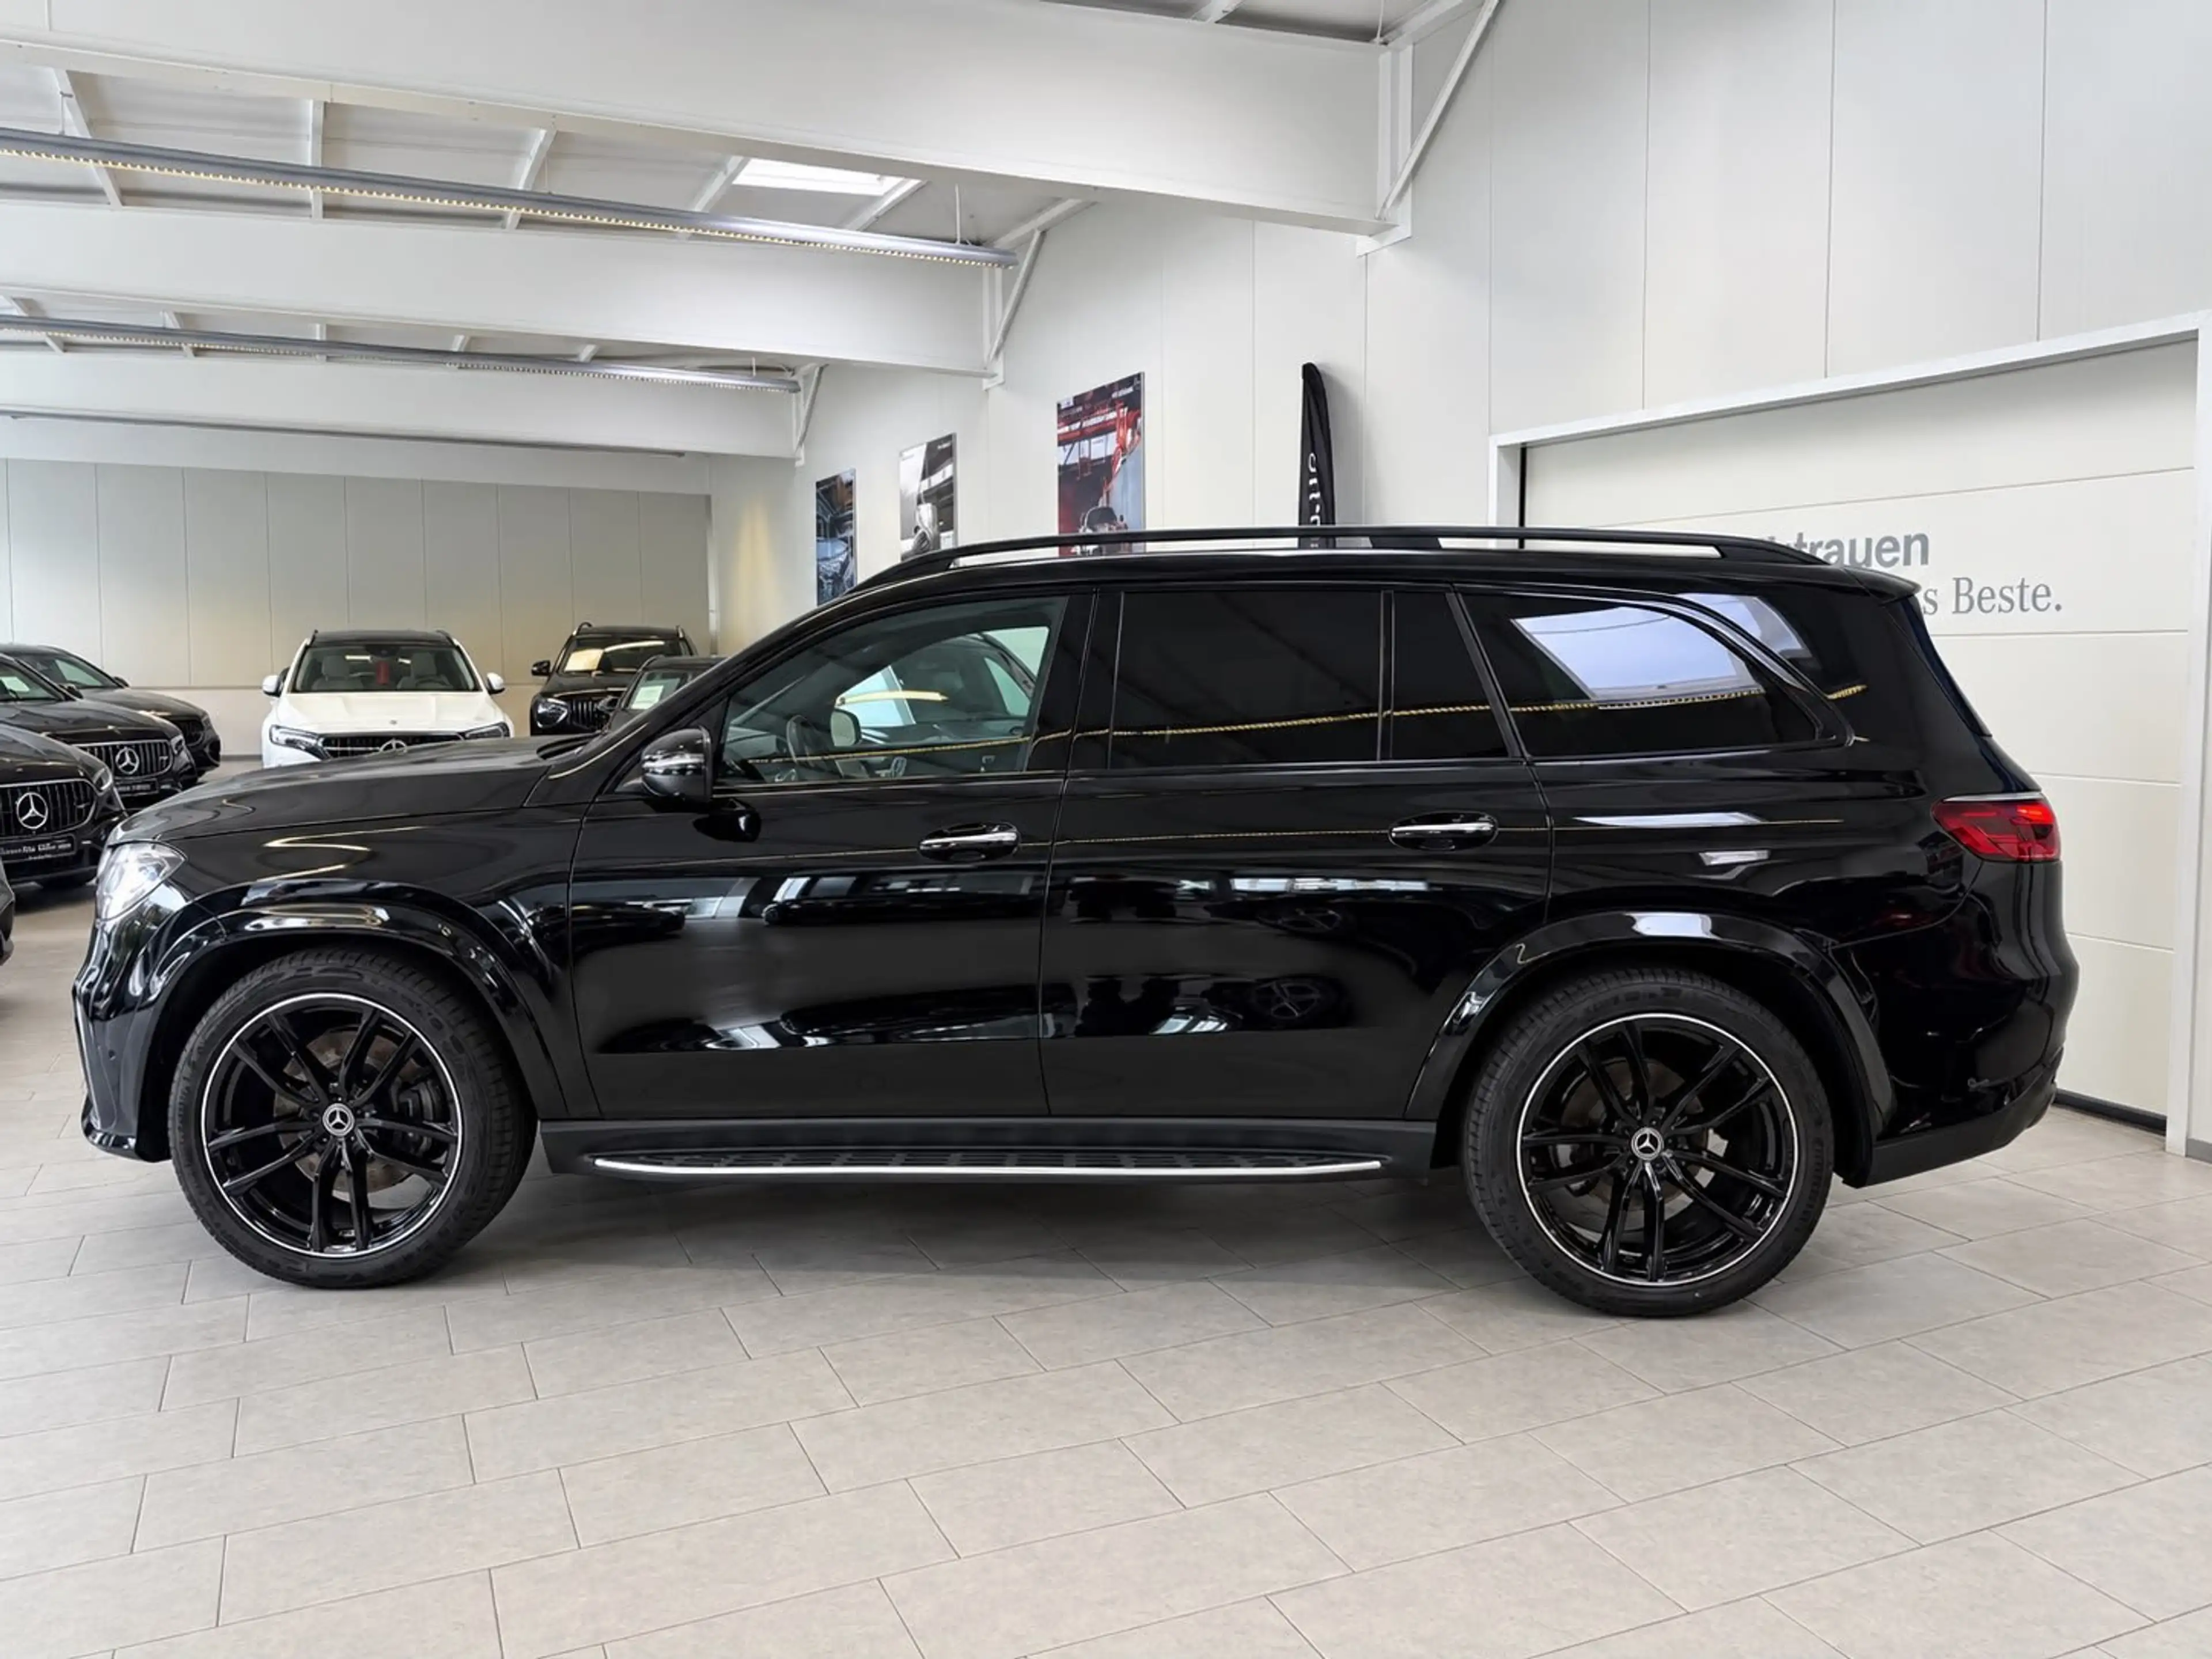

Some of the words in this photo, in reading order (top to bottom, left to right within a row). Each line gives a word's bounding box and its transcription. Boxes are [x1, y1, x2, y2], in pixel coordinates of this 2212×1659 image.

[1767, 532, 1929, 568] trauen
[1922, 588, 1938, 616] s
[1952, 577, 2062, 615] Beste.
